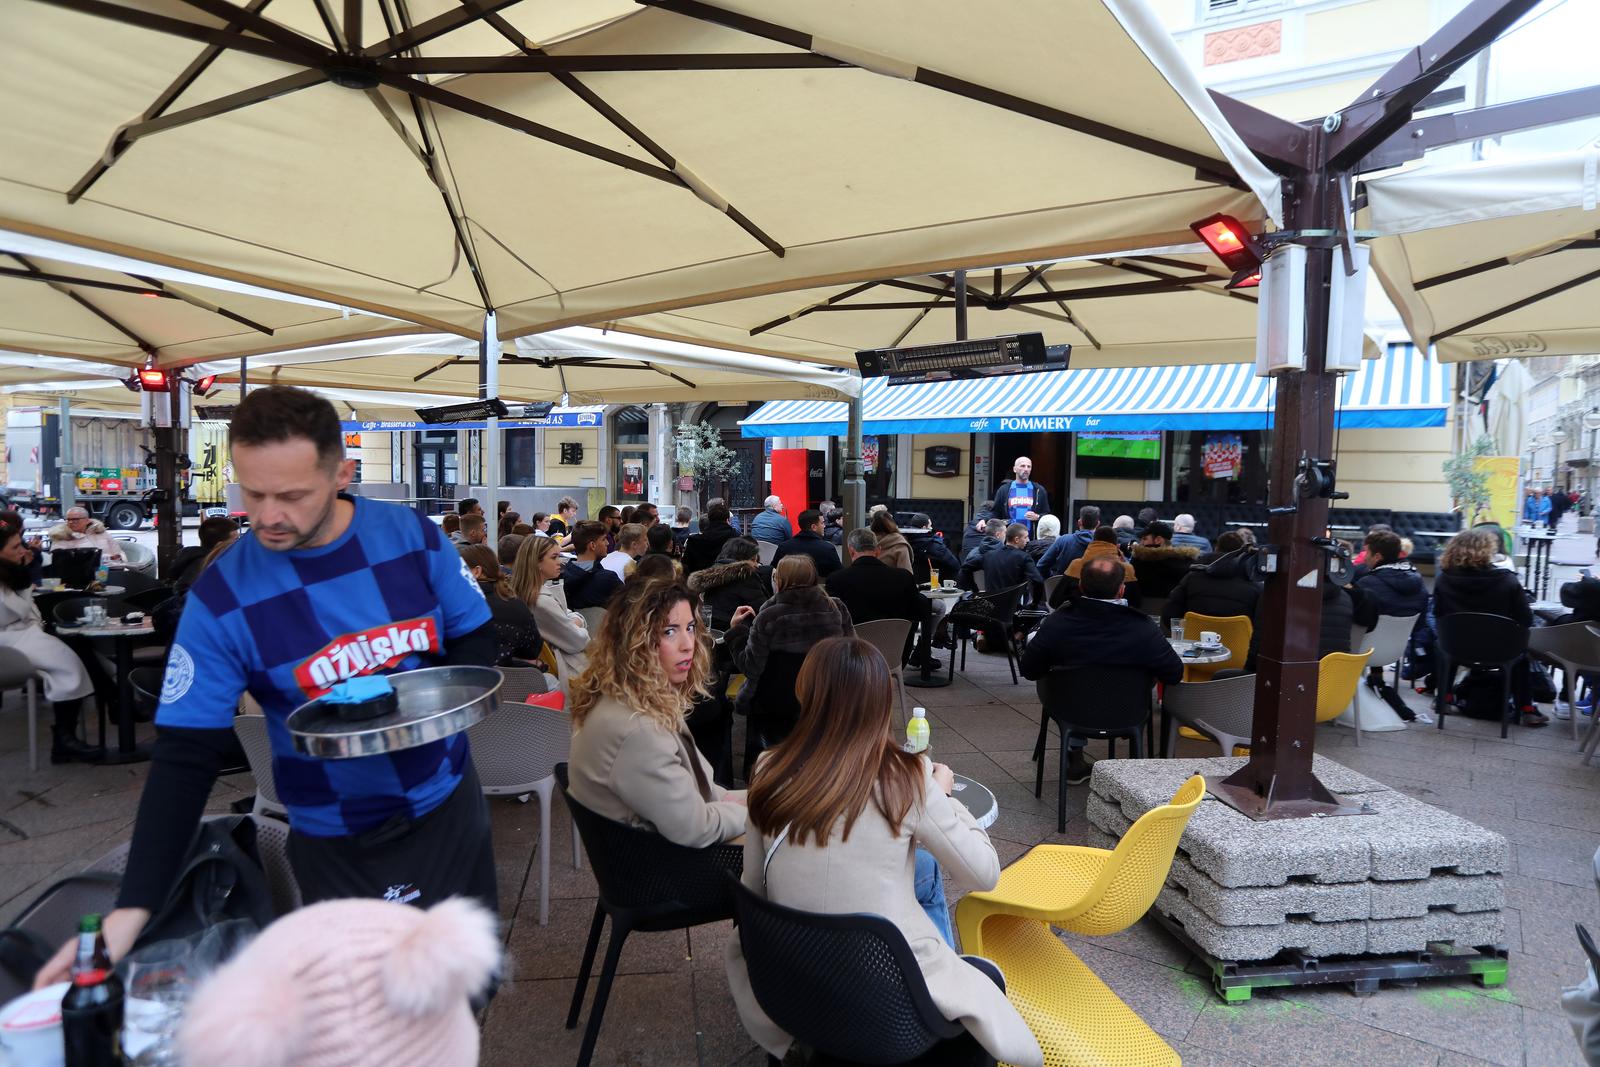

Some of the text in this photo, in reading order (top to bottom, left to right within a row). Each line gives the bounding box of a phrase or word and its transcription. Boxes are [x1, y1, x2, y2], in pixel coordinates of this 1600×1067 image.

[969, 416, 1101, 430] caffe POMMERY bar
